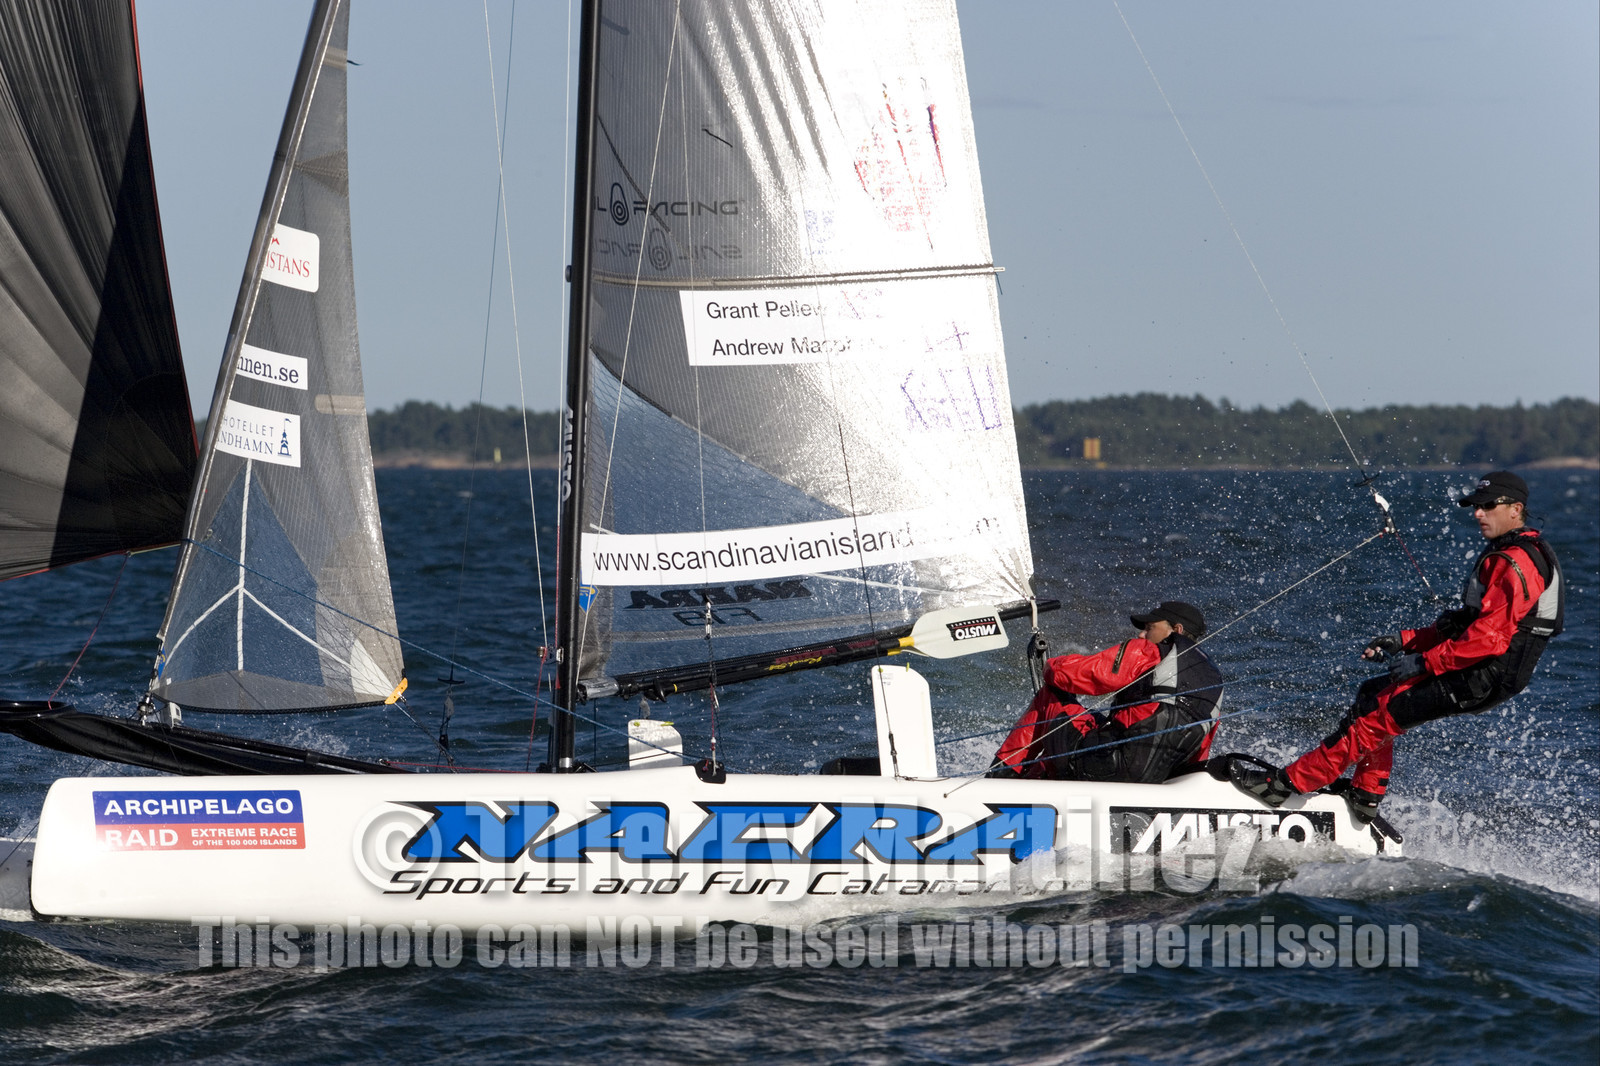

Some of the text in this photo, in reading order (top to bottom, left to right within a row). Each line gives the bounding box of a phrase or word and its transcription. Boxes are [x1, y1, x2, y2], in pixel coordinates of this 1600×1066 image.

[706, 301, 760, 319] Grant
[712, 338, 784, 357] Andrew
[224, 416, 274, 437] HOTELLET
[955, 624, 996, 640] MUSTO
[104, 798, 294, 815] ARCHIPELAGO
[105, 827, 297, 847] RAID EXTREME RACE
[383, 870, 576, 900] Sports
[592, 873, 689, 894] and
[699, 871, 790, 895] Fun
